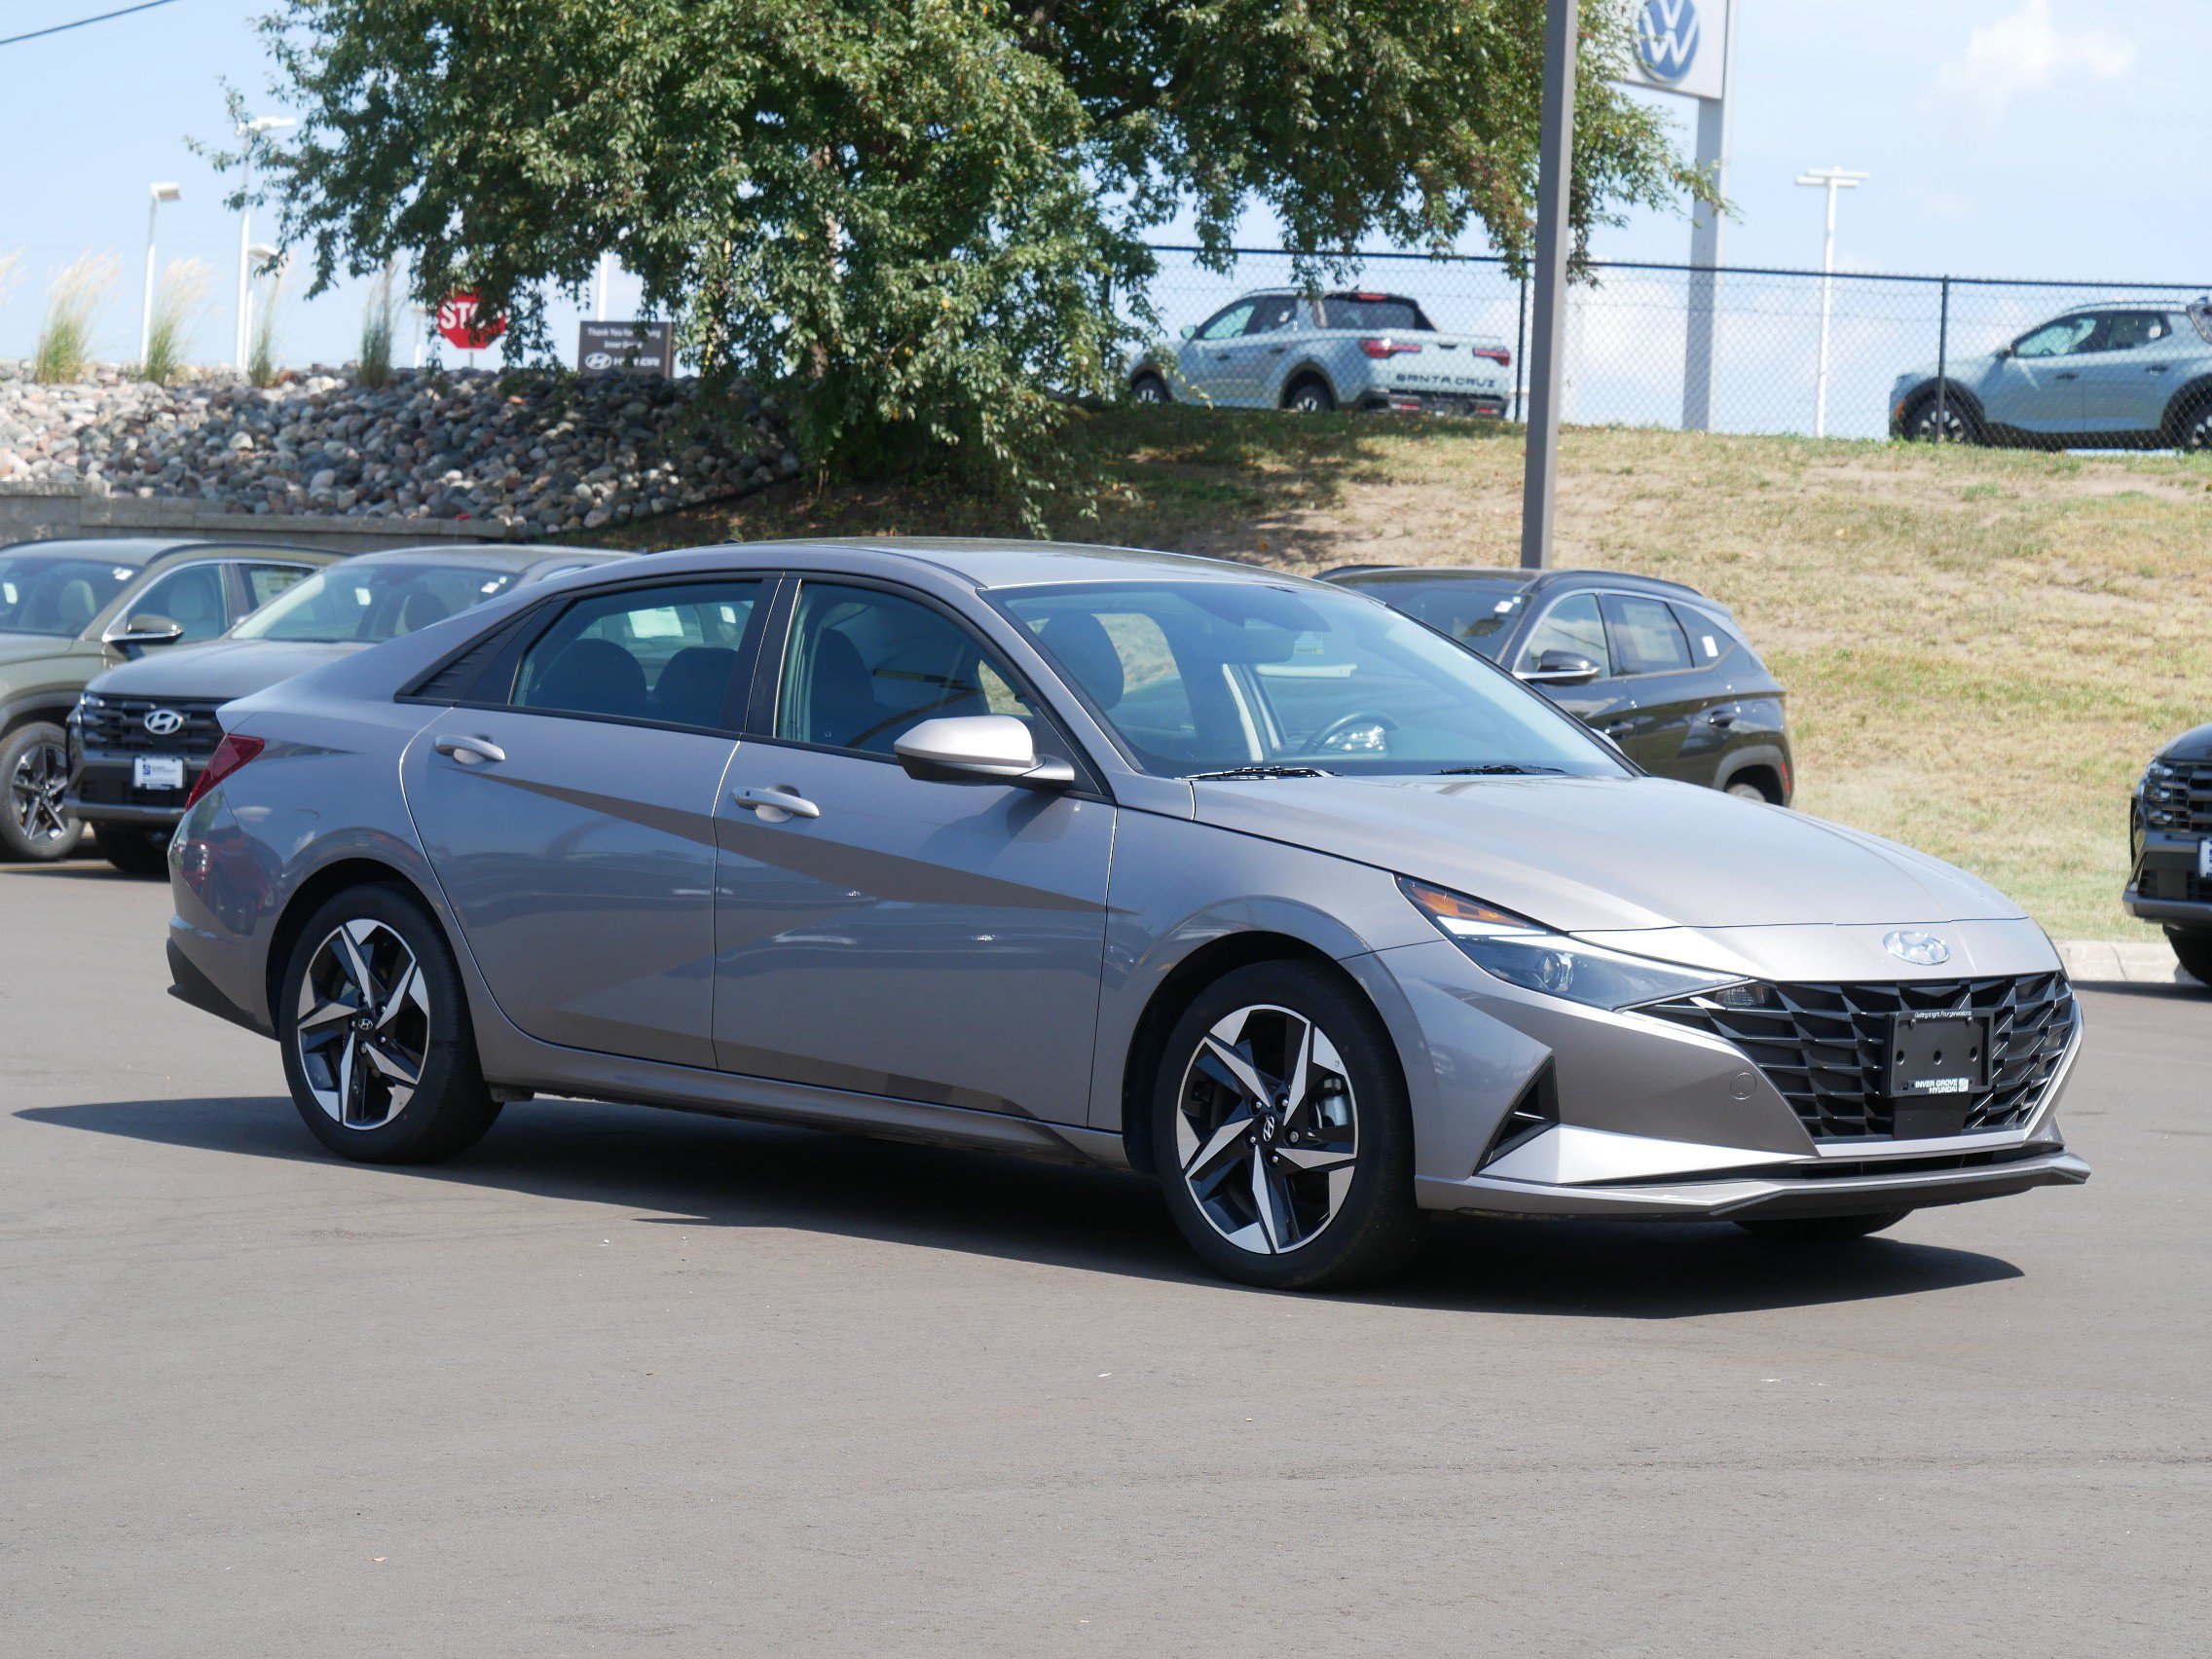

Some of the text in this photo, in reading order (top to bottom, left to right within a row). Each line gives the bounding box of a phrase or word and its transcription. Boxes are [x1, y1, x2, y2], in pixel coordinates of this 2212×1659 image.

[440, 300, 503, 330] STO
[586, 326, 608, 337] Thank
[609, 327, 622, 337] You
[612, 356, 660, 367] HNDAI
[1395, 374, 1495, 387] SANTA CRUZ
[1914, 1078, 1958, 1088] INVER GROVE
